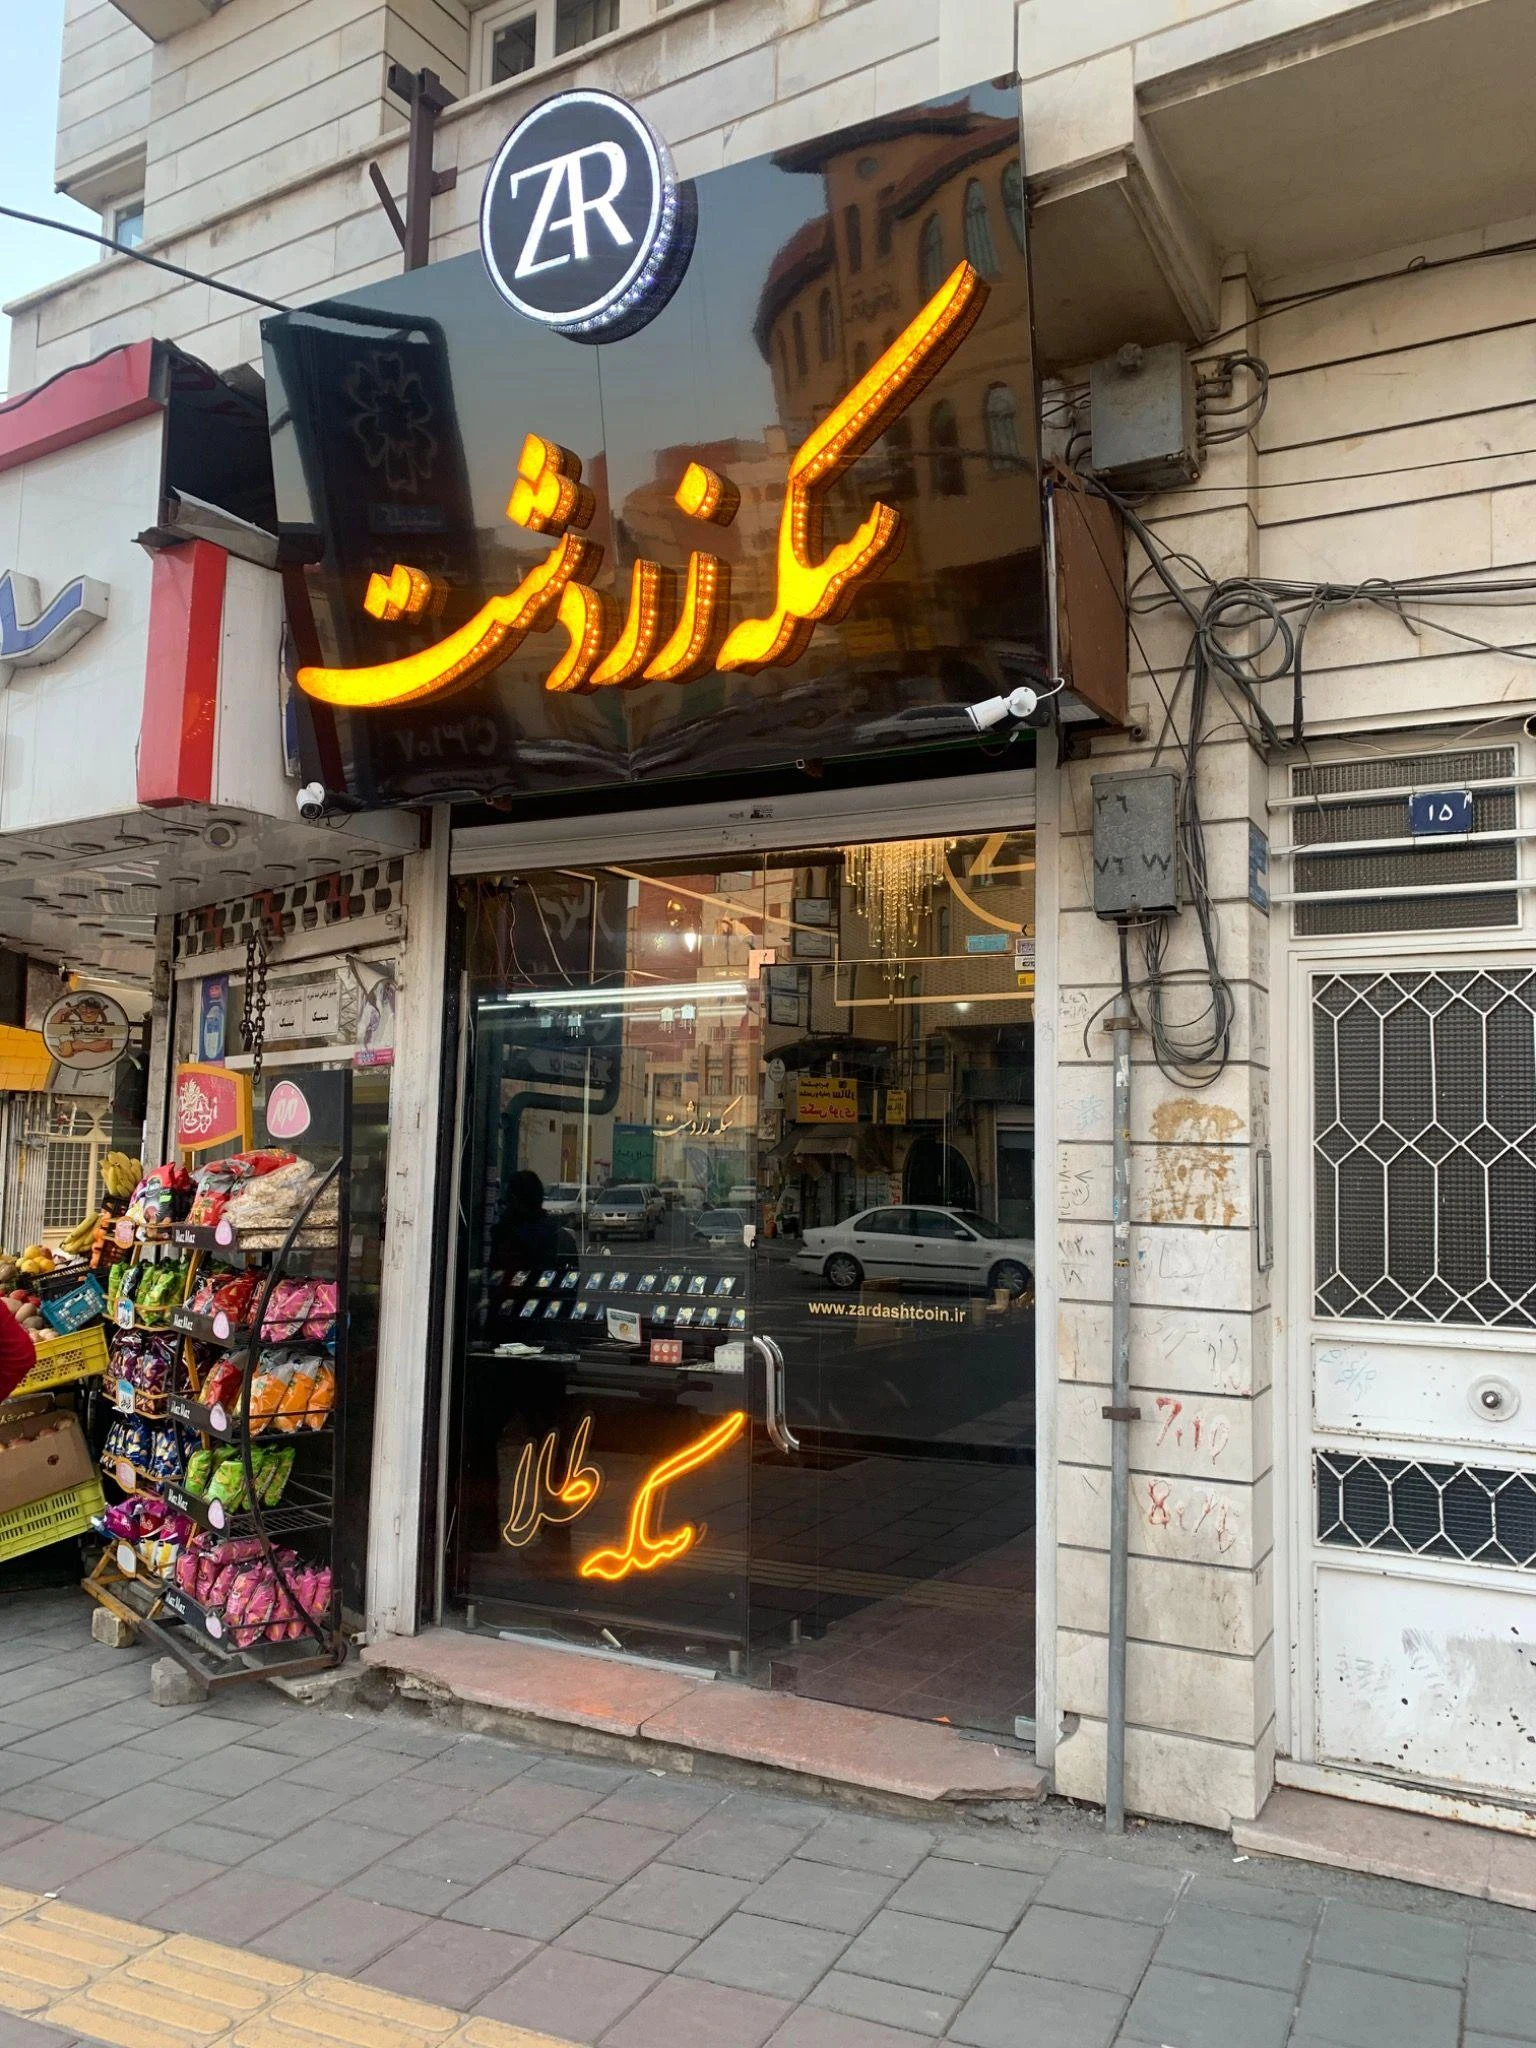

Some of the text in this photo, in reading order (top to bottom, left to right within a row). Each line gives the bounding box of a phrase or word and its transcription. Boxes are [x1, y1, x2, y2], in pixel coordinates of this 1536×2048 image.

[716, 258, 983, 673] سکه
[1428, 803, 1454, 822] ۱۵
[712, 1095, 744, 1137] سکه
[808, 1301, 967, 1323] www.zardashtcoin.ir
[503, 1412, 745, 1580] سکه طلا
